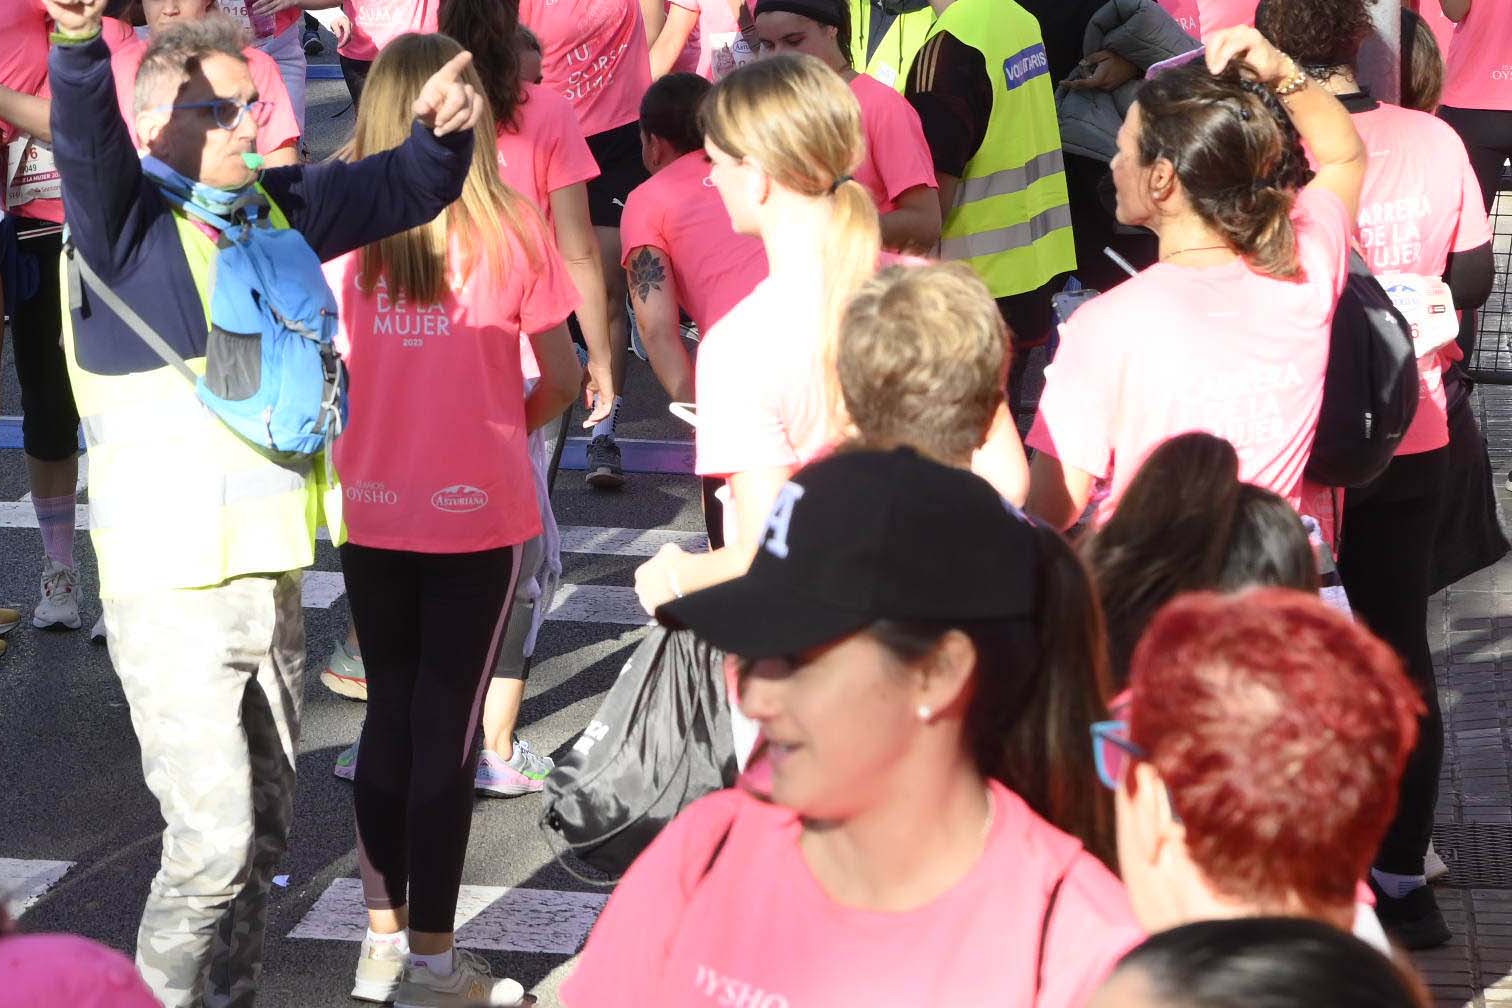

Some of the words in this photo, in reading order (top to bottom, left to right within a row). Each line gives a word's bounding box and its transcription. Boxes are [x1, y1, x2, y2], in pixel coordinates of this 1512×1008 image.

[1357, 194, 1432, 227] ARRERA
[1374, 244, 1422, 268] UJER
[377, 293, 407, 313] DE
[373, 314, 451, 335] MUJER
[347, 487, 397, 505] OYSHO
[437, 495, 484, 506] ASTURIANA
[758, 482, 805, 559] A
